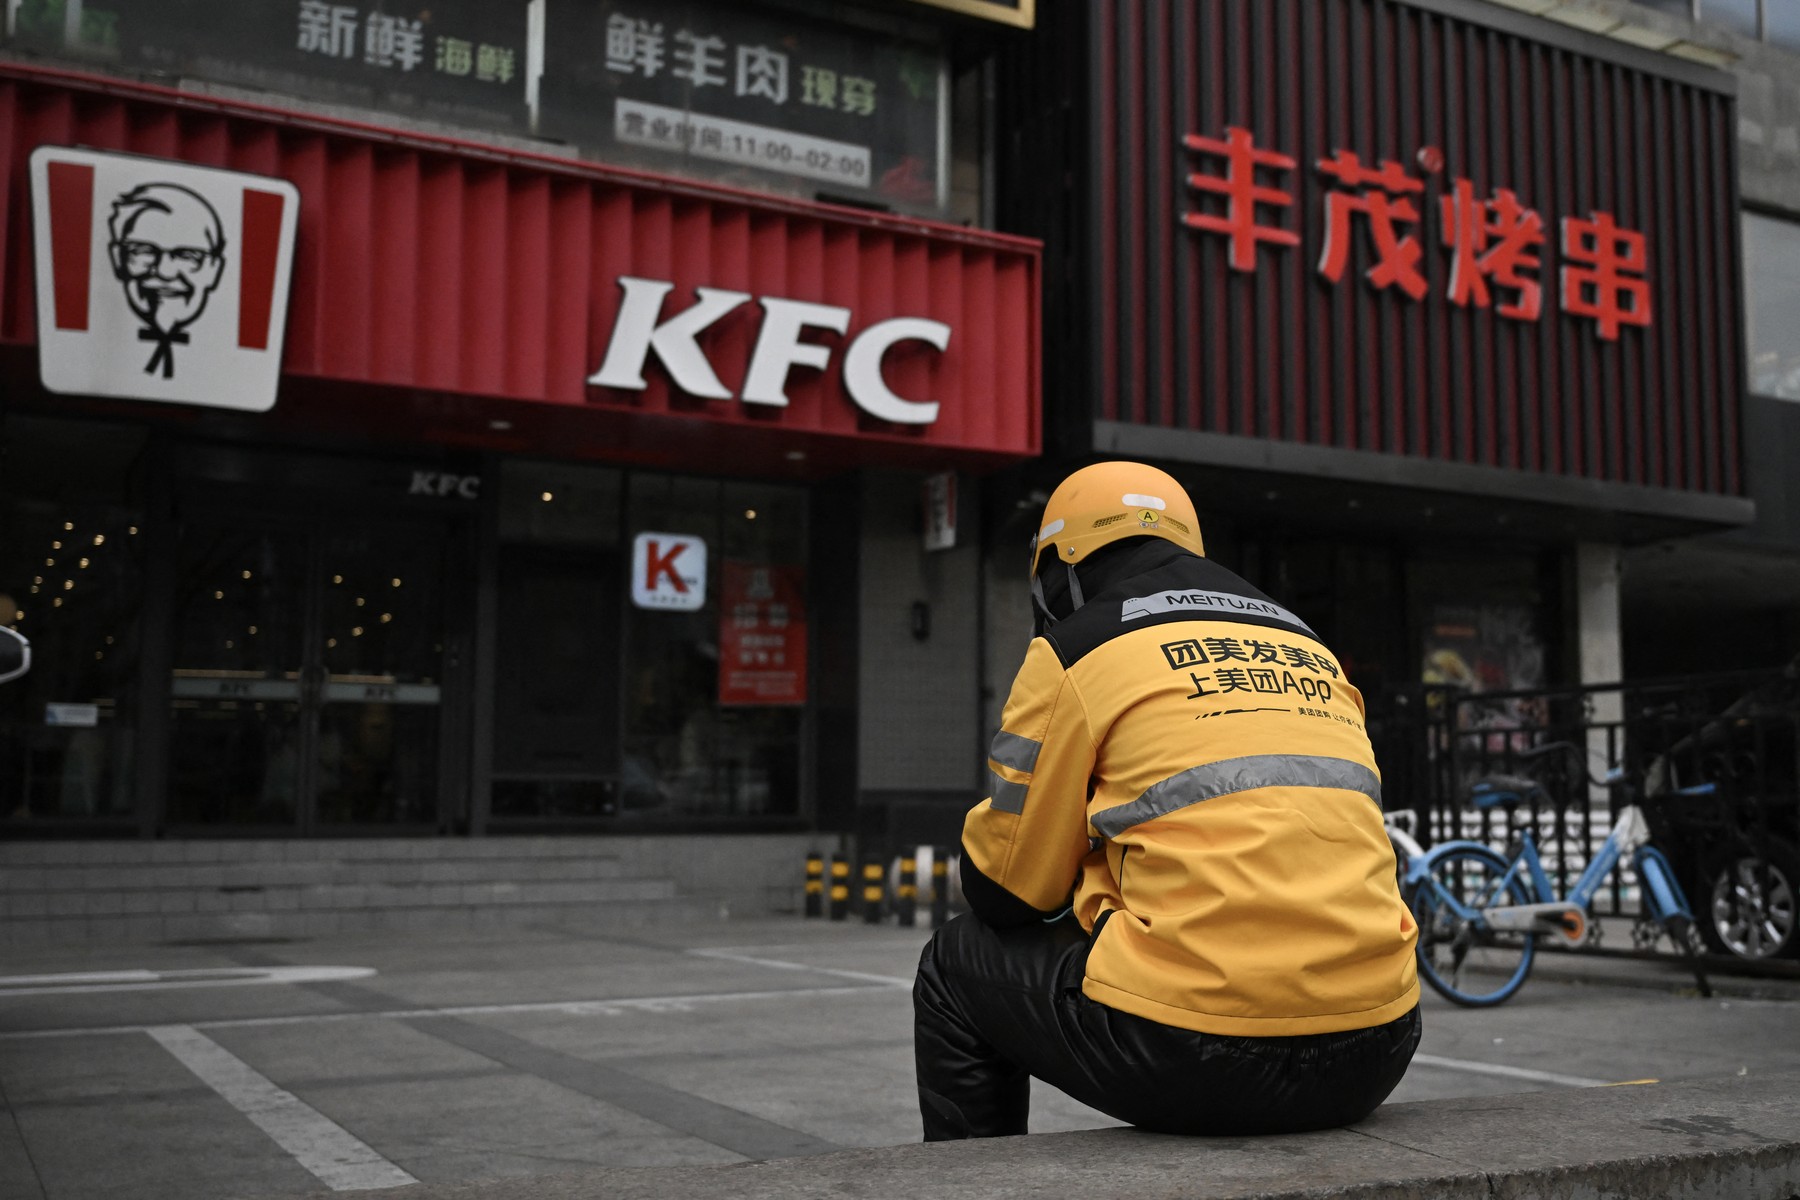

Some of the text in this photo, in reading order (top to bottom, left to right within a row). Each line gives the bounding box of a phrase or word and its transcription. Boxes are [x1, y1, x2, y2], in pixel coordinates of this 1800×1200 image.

[296, 0, 516, 84] 新鲜 海鲜
[605, 13, 789, 106] 鲜羊肉
[1181, 126, 1653, 342] 丰茂烤串
[587, 275, 952, 426] KFC
[408, 470, 481, 499] KFC
[1143, 511, 1153, 521] A
[646, 540, 690, 594] K
[1165, 594, 1280, 616] MEITUAN
[1160, 637, 1339, 679] 团美发美甲
[1187, 668, 1332, 704] 上美团App
